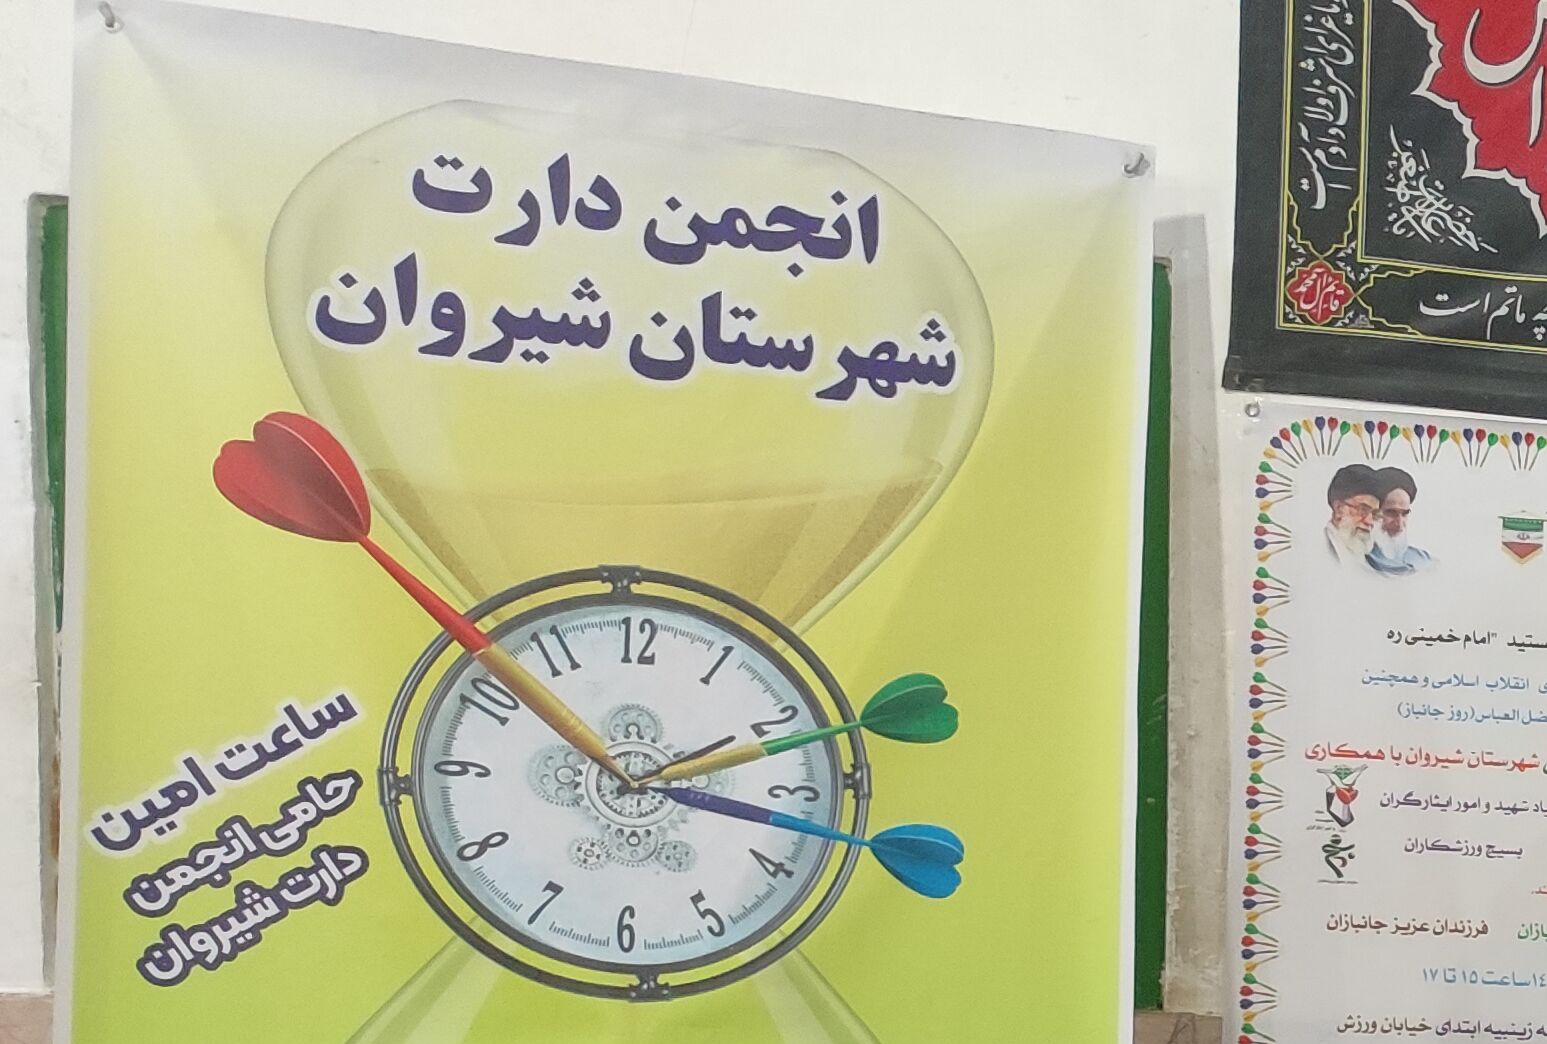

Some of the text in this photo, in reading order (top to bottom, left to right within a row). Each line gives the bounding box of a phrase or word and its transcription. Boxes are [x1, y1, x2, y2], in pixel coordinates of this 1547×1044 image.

[412, 153, 881, 277] انجمن دارت
[1419, 292, 1490, 316] است
[313, 257, 958, 400] شهرستان شیروان
[620, 617, 656, 665] 12
[1387, 628, 1402, 644] ره
[1404, 627, 1461, 647] خمینی
[530, 625, 581, 677] 11
[700, 646, 735, 685] 1
[1361, 669, 1419, 687] همچنین
[1431, 673, 1479, 689] اسلامی
[1485, 675, 1530, 692] انقلاب
[460, 677, 520, 726] 10
[751, 705, 800, 738] 2
[1304, 741, 1386, 762] همکاری
[1390, 745, 1402, 766] با
[1405, 745, 1464, 768] شیروان
[1467, 750, 1541, 772] شهرستان
[90, 693, 358, 851] ساعت امین
[434, 759, 491, 779] 9
[767, 784, 820, 803] 3
[1380, 791, 1452, 812] ایثارگران
[1455, 797, 1481, 812] امور
[132, 776, 355, 911] حامی انجمن
[456, 831, 510, 861] 8
[1404, 837, 1523, 859] بسیج ورزشکاران
[750, 847, 795, 880] 4
[528, 880, 564, 925] 7
[689, 889, 725, 938] 5
[146, 850, 363, 980] دارت شیروان
[1326, 914, 1489, 938] فرزندان عزیز جانبازان
[617, 906, 636, 953] 6
[1443, 968, 1457, 983] تا
[1336, 1014, 1378, 1034] ورزش
[1380, 1017, 1432, 1037] خیابان
[1435, 1019, 1481, 1039] ابتدای
[1483, 1022, 1533, 1041] زینبیه
